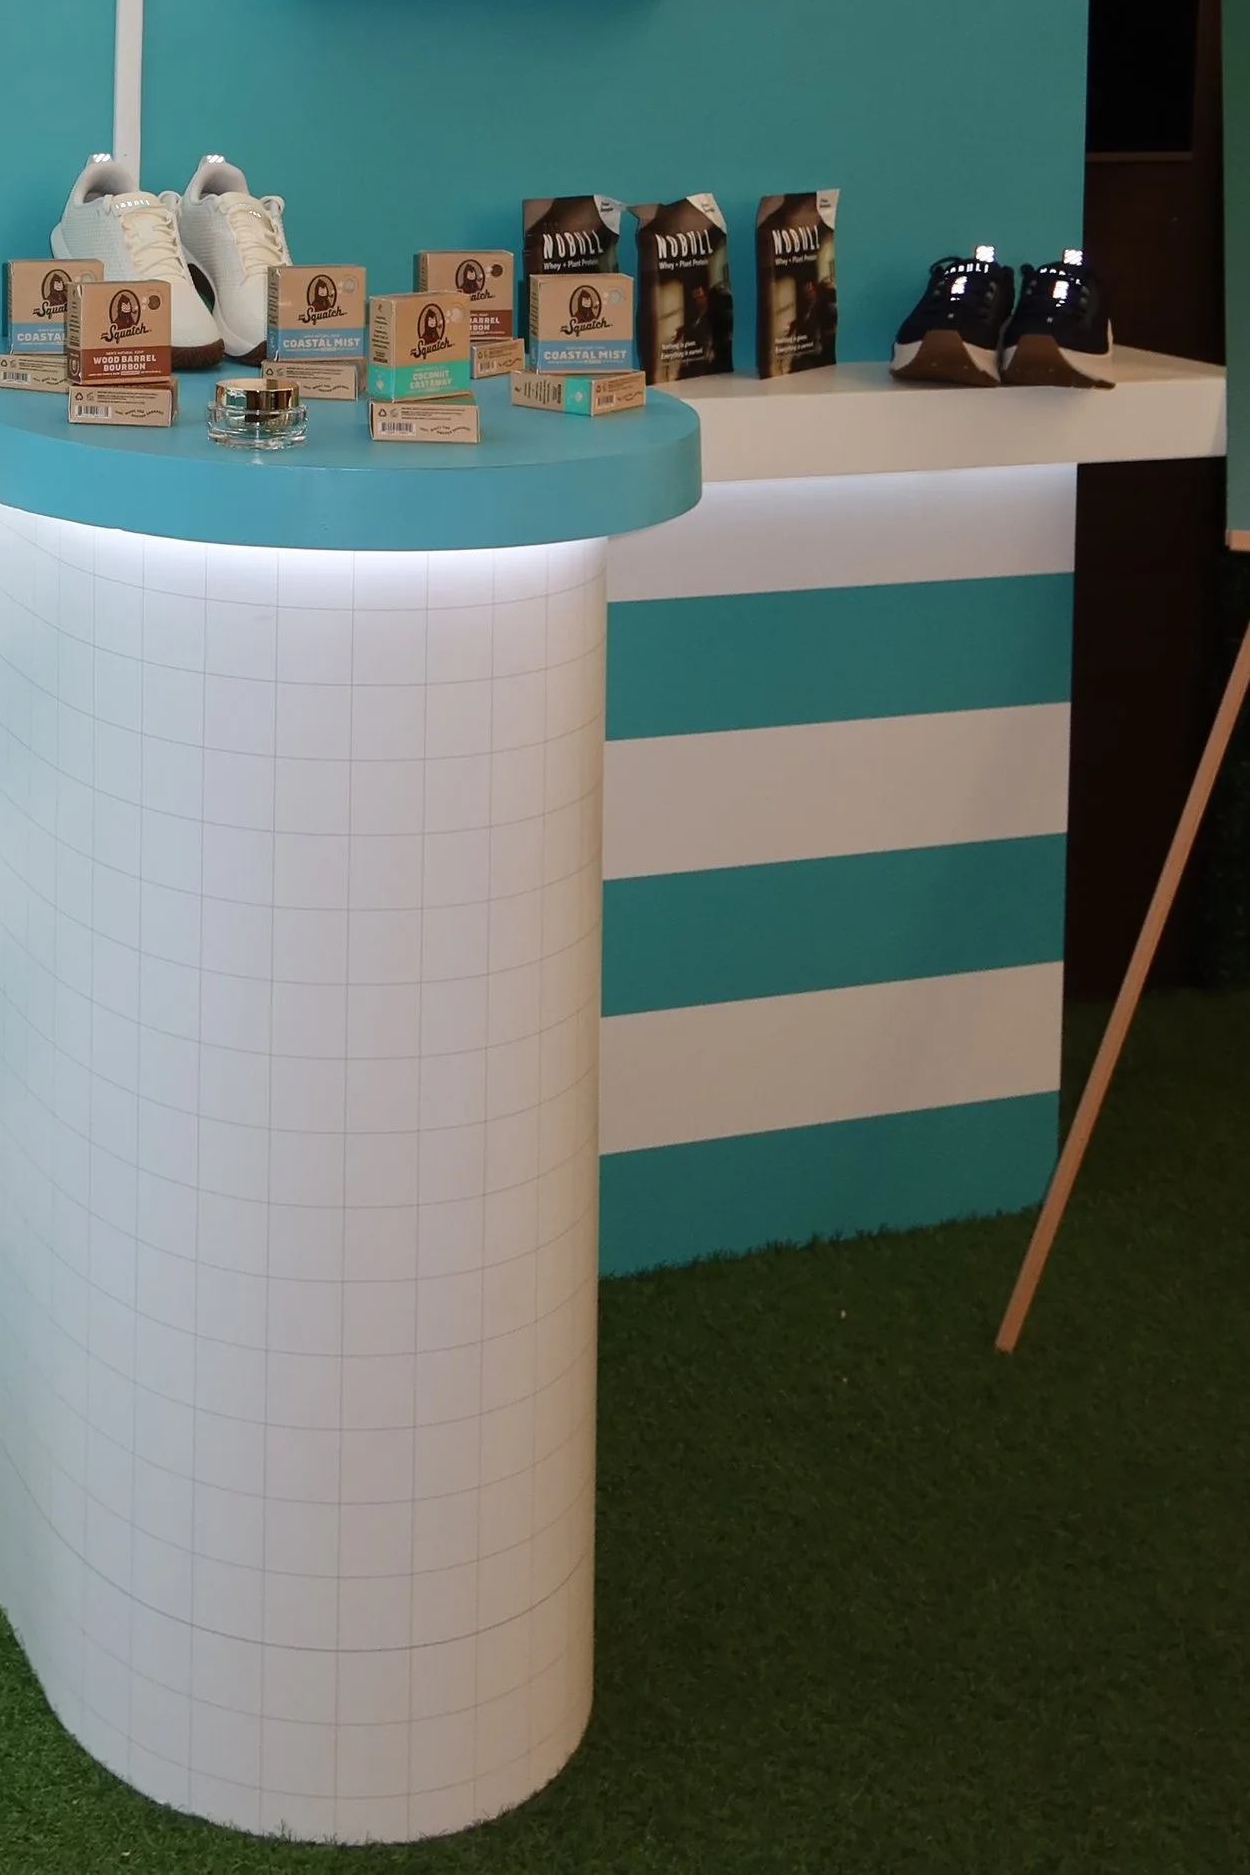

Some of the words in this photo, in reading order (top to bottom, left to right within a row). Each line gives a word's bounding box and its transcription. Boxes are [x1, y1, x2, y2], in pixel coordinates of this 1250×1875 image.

[543, 229, 604, 260] NOBULL
[655, 229, 713, 259] NOBULL
[771, 225, 820, 255] NOBULL
[543, 262, 561, 271] Whey
[568, 261, 581, 269] Plant
[33, 301, 67, 319] Squat
[298, 306, 345, 325] Squatch
[100, 323, 149, 344] Squatch
[560, 317, 610, 337] Squatch
[283, 338, 332, 348] COASTAL
[334, 338, 361, 347] MIST
[410, 338, 453, 359] Squatch
[93, 356, 120, 365] WOOD
[121, 354, 157, 363] BARREL
[543, 351, 596, 360] COASTAL
[598, 350, 627, 360] MIST
[103, 363, 146, 372] BOURBON
[413, 370, 450, 380] COCONUT
[409, 379, 453, 389] CASTAWAY
